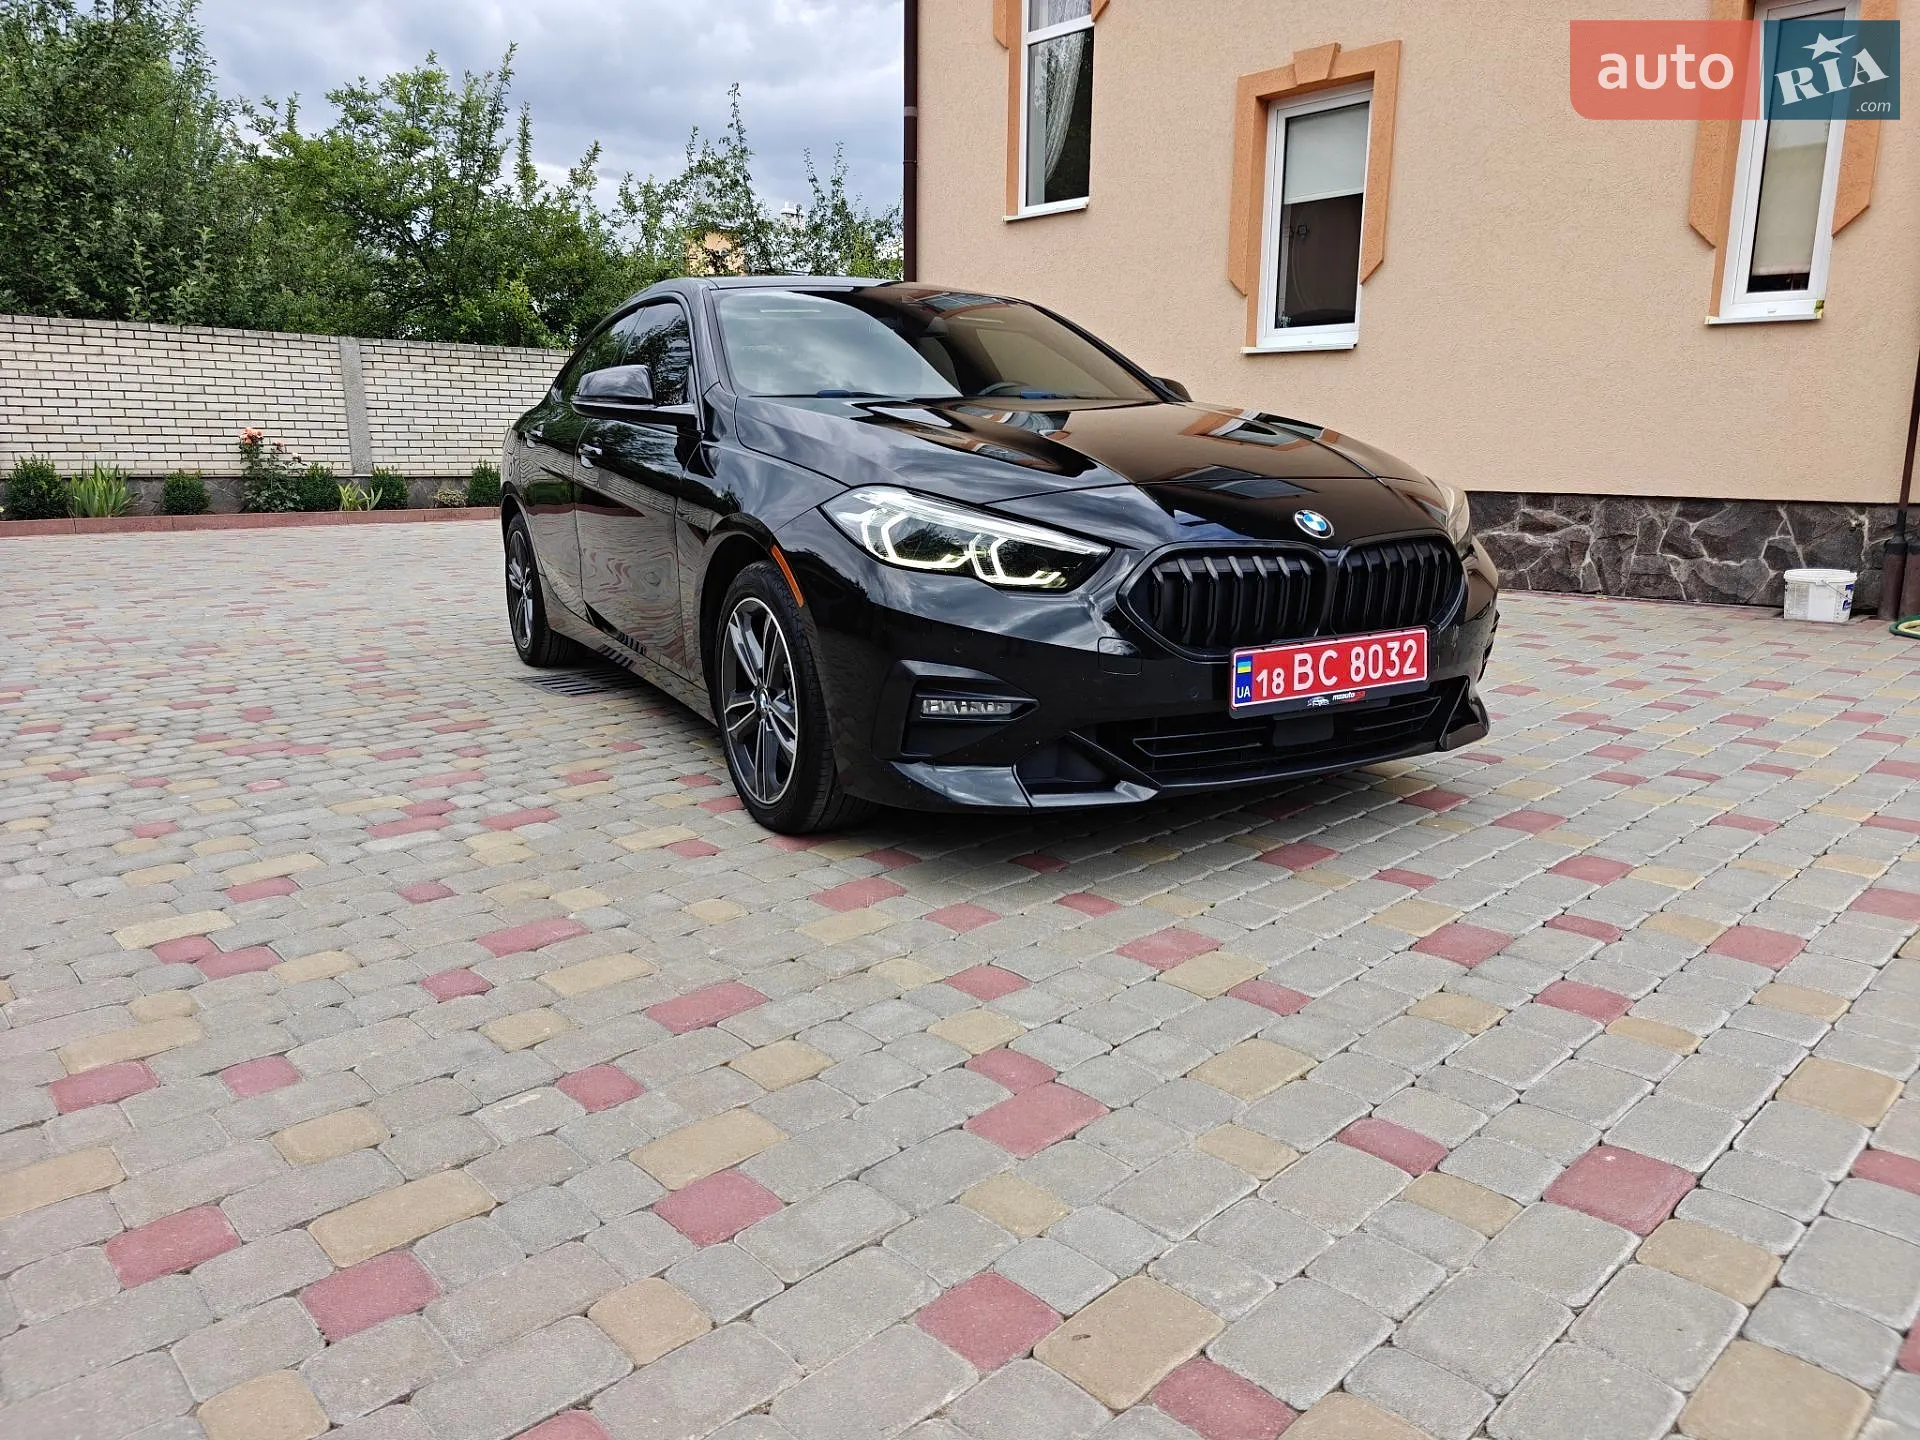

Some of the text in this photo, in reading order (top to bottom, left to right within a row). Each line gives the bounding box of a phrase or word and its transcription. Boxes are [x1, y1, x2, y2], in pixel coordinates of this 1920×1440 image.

[1256, 639, 1417, 697] 18 BC 8032
[1237, 685, 1250, 698] UA
